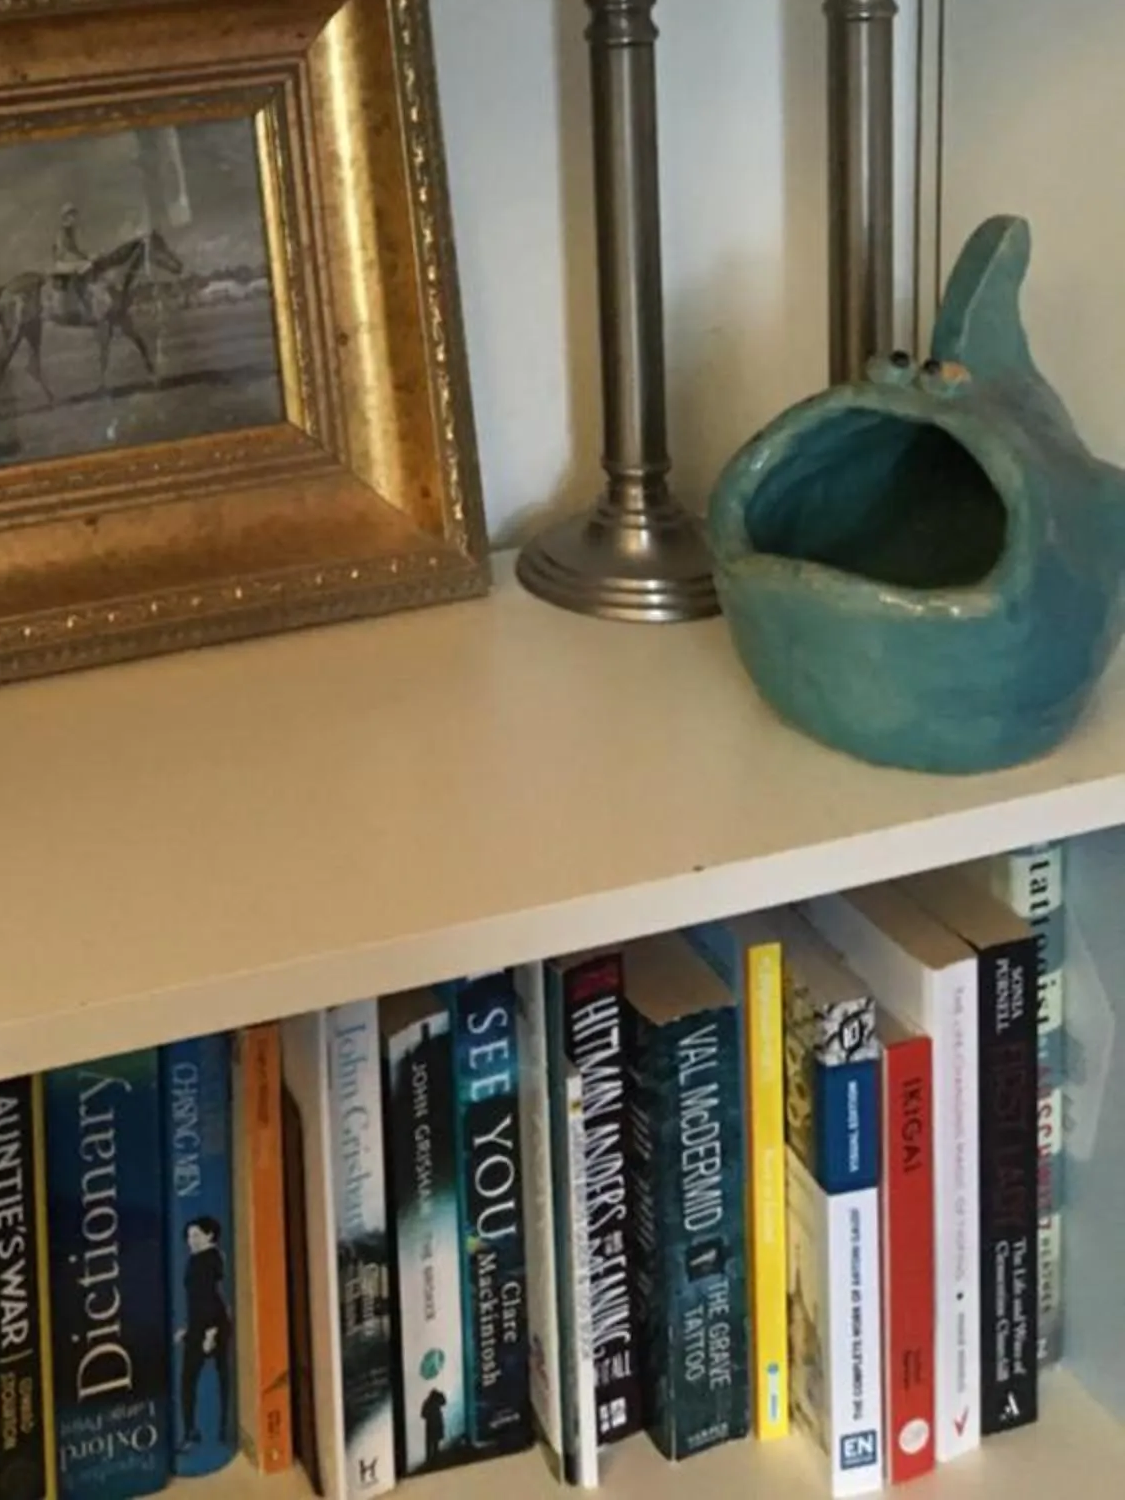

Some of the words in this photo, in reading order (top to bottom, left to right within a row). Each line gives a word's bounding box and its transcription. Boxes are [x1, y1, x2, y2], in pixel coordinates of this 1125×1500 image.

[994, 957, 1011, 1036] PURNELL
[1011, 965, 1025, 1020] SONIA
[333, 1022, 368, 1098] John
[410, 1060, 429, 1118] JOHN
[466, 1006, 511, 1102] SEE
[570, 995, 624, 1118] HITMAN
[677, 1023, 720, 1085] VAL
[679, 1083, 724, 1233] McDERMID
[901, 1076, 925, 1175] IKIGAI
[341, 1106, 373, 1229] Grisham
[414, 1125, 434, 1220] GRISHAM
[472, 1114, 517, 1241] YOU
[582, 1122, 627, 1231] ANDERS
[68, 1070, 133, 1401] Dictionary
[1012, 1236, 1028, 1266] The
[499, 1280, 523, 1343] Clare
[705, 1279, 730, 1320] THE
[1012, 1267, 1028, 1295] Life
[1013, 1298, 1028, 1322] and
[475, 1252, 499, 1388] Mackintosh
[682, 1304, 706, 1383] TATTOO
[707, 1321, 733, 1392] GRAVE
[59, 1423, 159, 1474] Oxford
[844, 1435, 875, 1460] EN
